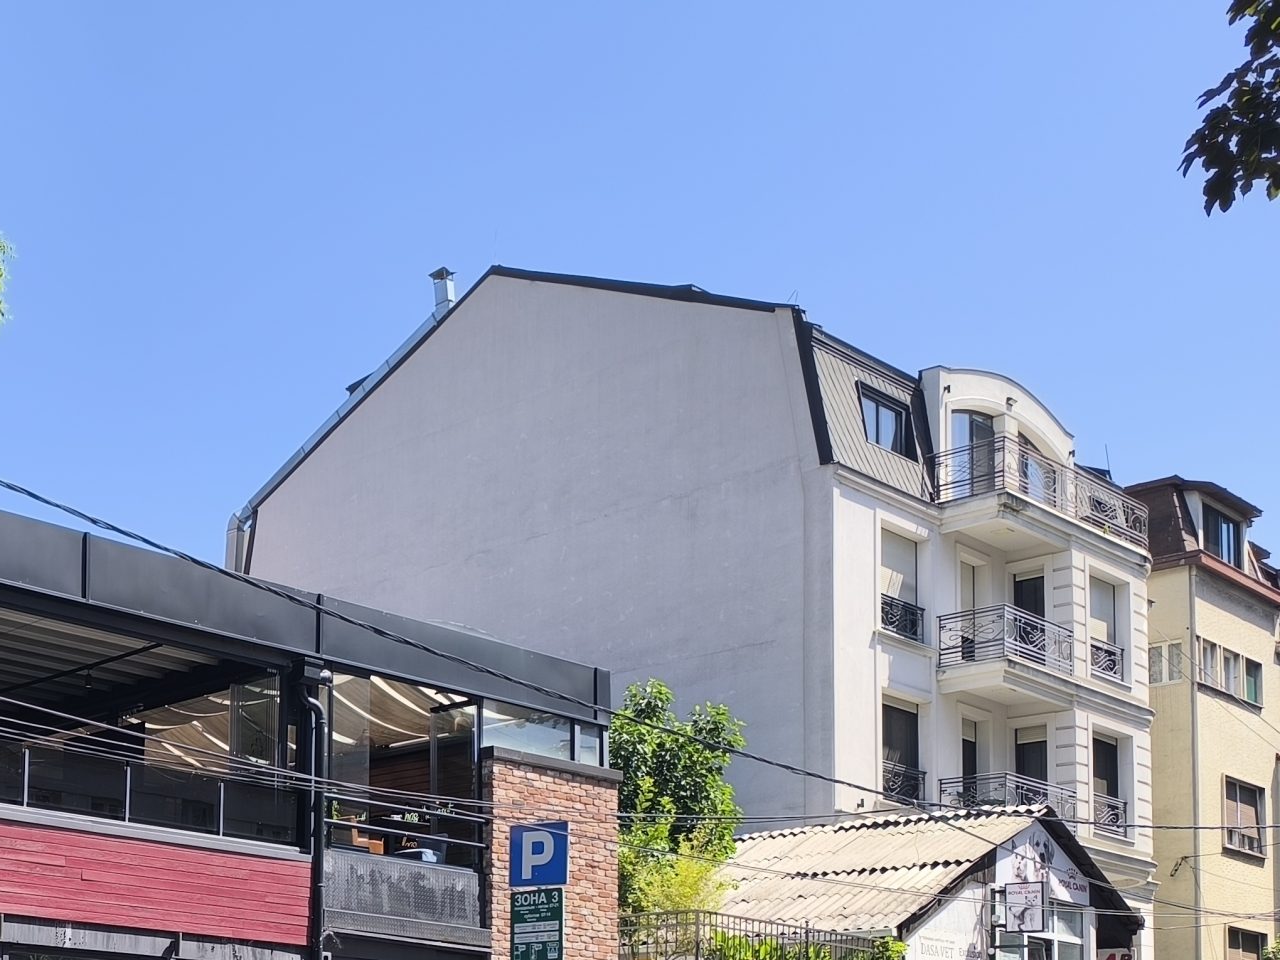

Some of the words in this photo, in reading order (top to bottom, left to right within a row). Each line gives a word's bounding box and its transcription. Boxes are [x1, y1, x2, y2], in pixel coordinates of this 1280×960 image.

[521, 830, 555, 880] P
[514, 892, 548, 907] ЗОНА
[551, 891, 559, 903] 3
